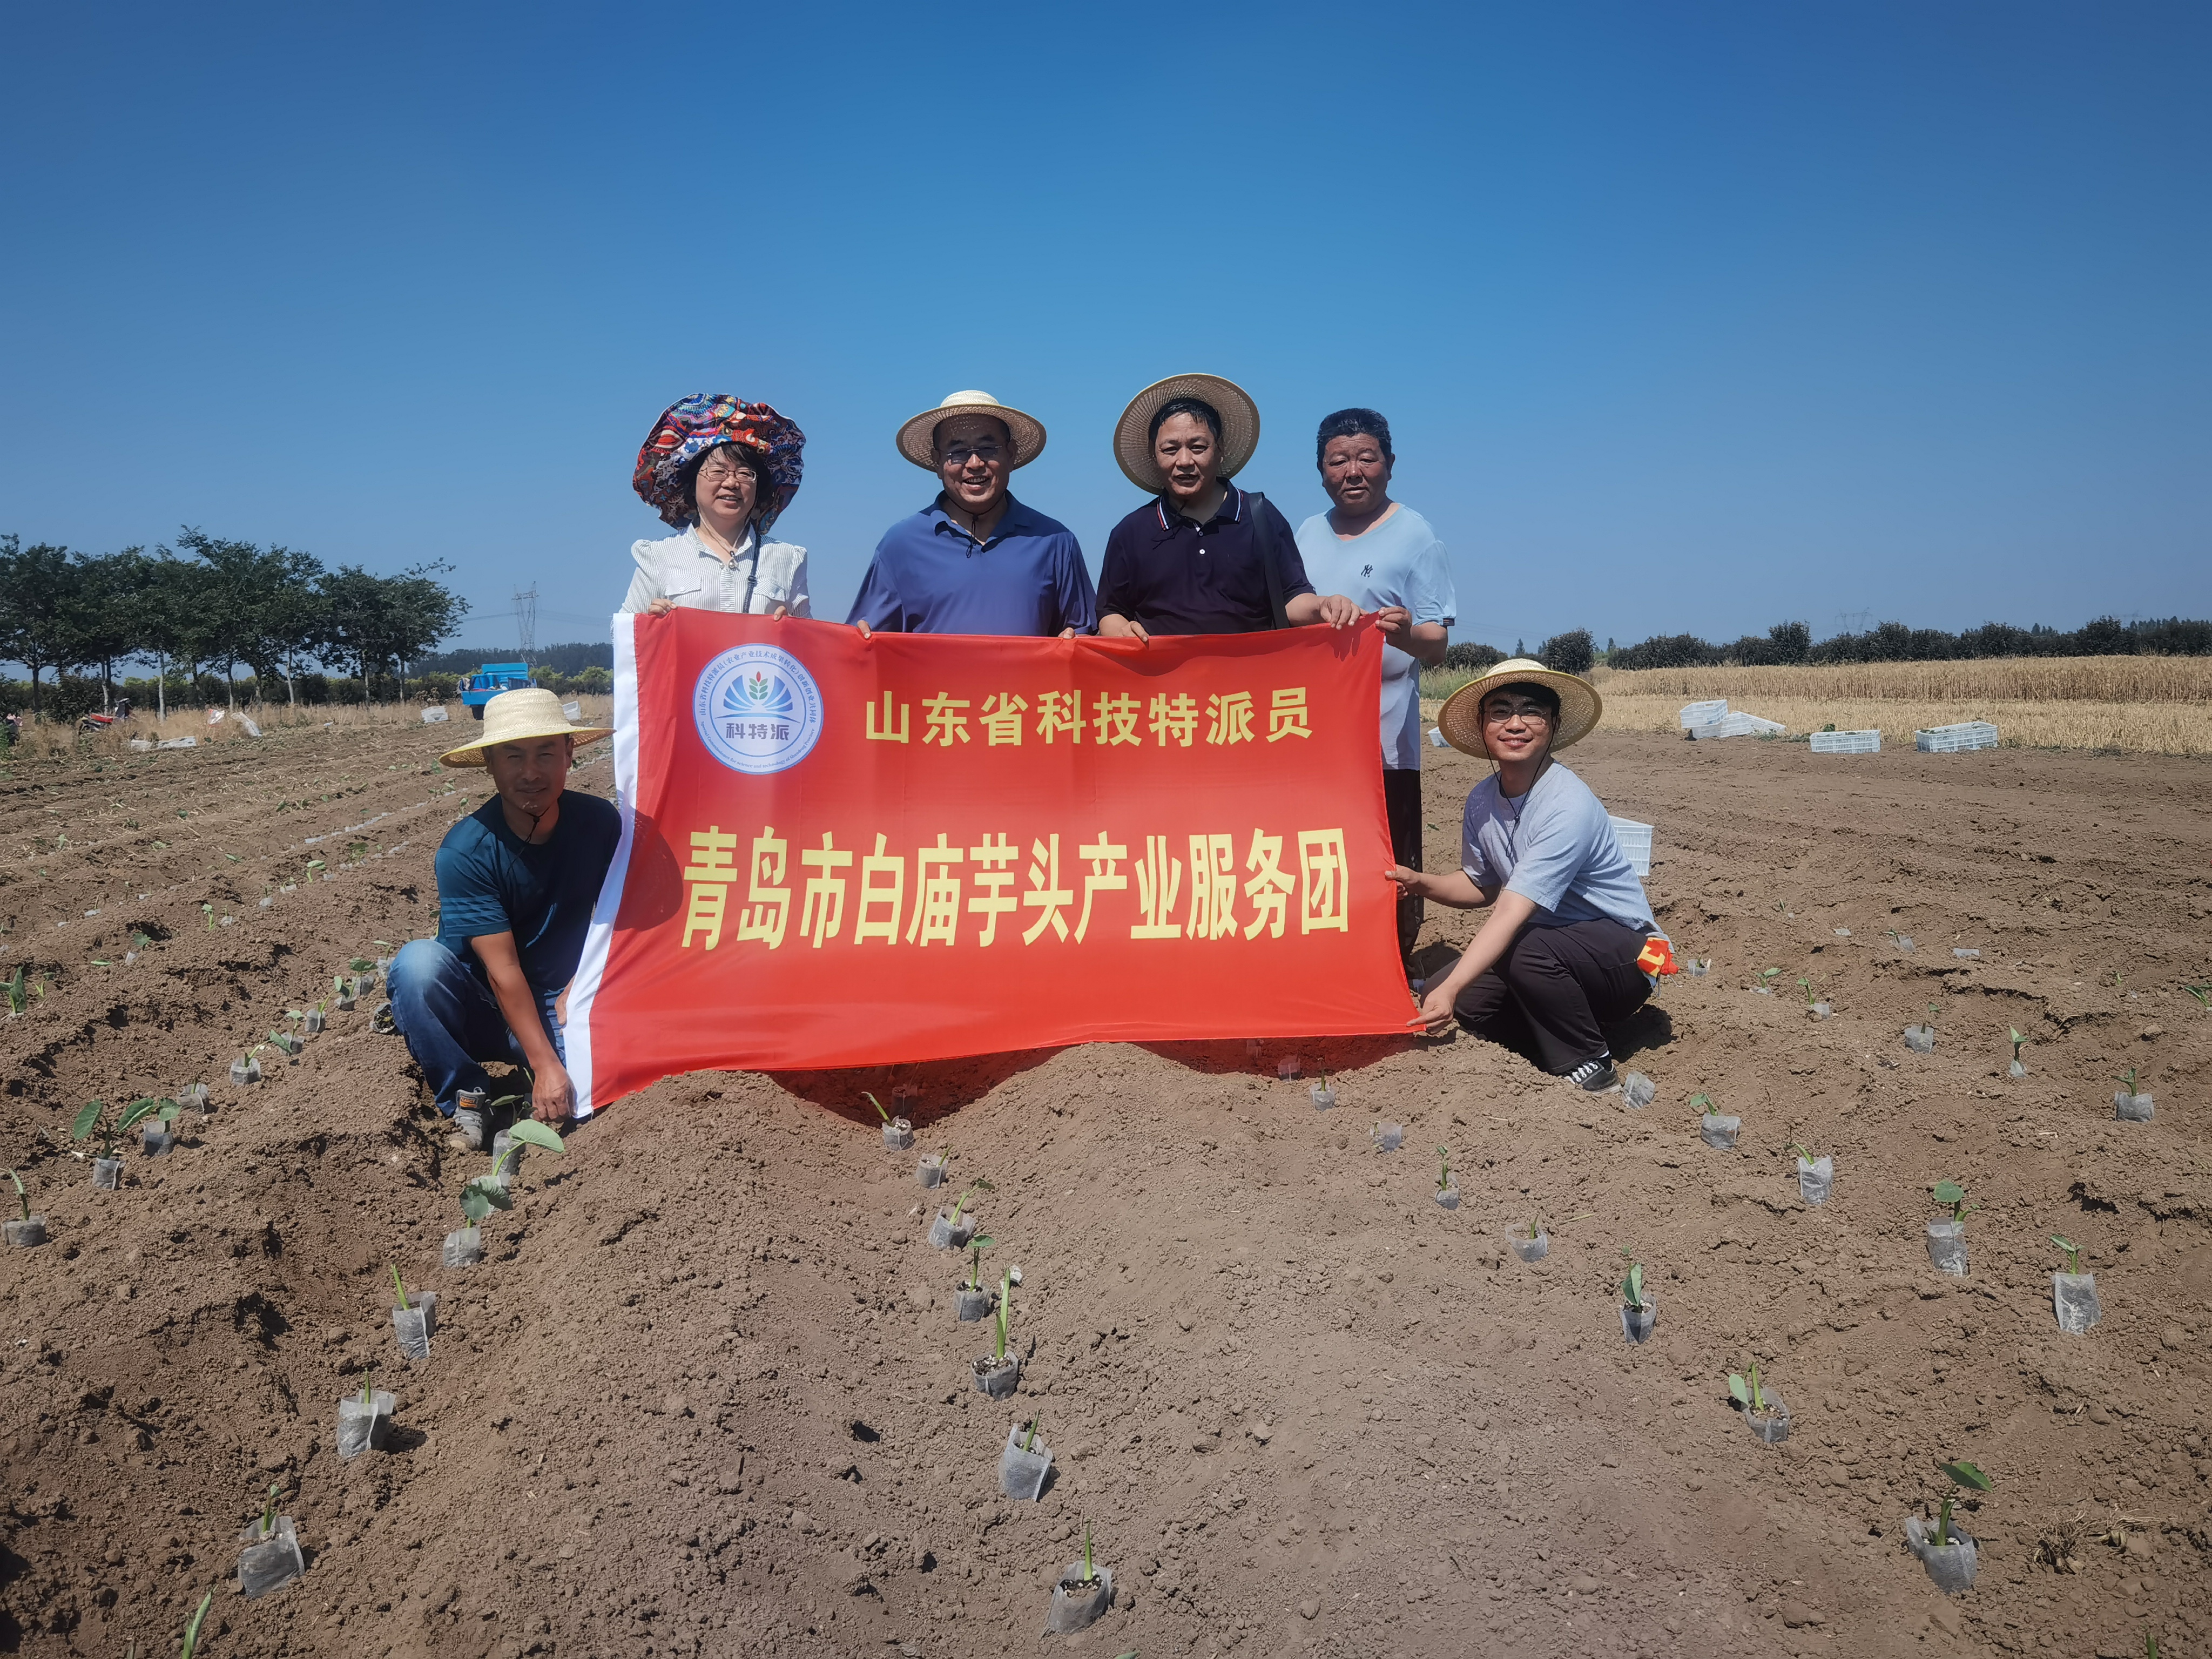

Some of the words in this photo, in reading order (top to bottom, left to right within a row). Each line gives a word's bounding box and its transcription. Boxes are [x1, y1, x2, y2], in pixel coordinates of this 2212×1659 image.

[726, 723, 789, 740] 科特派
[866, 687, 1313, 747] 山东省科技特派员
[682, 825, 1349, 950] 青岛市白庙芋头产业服务团
